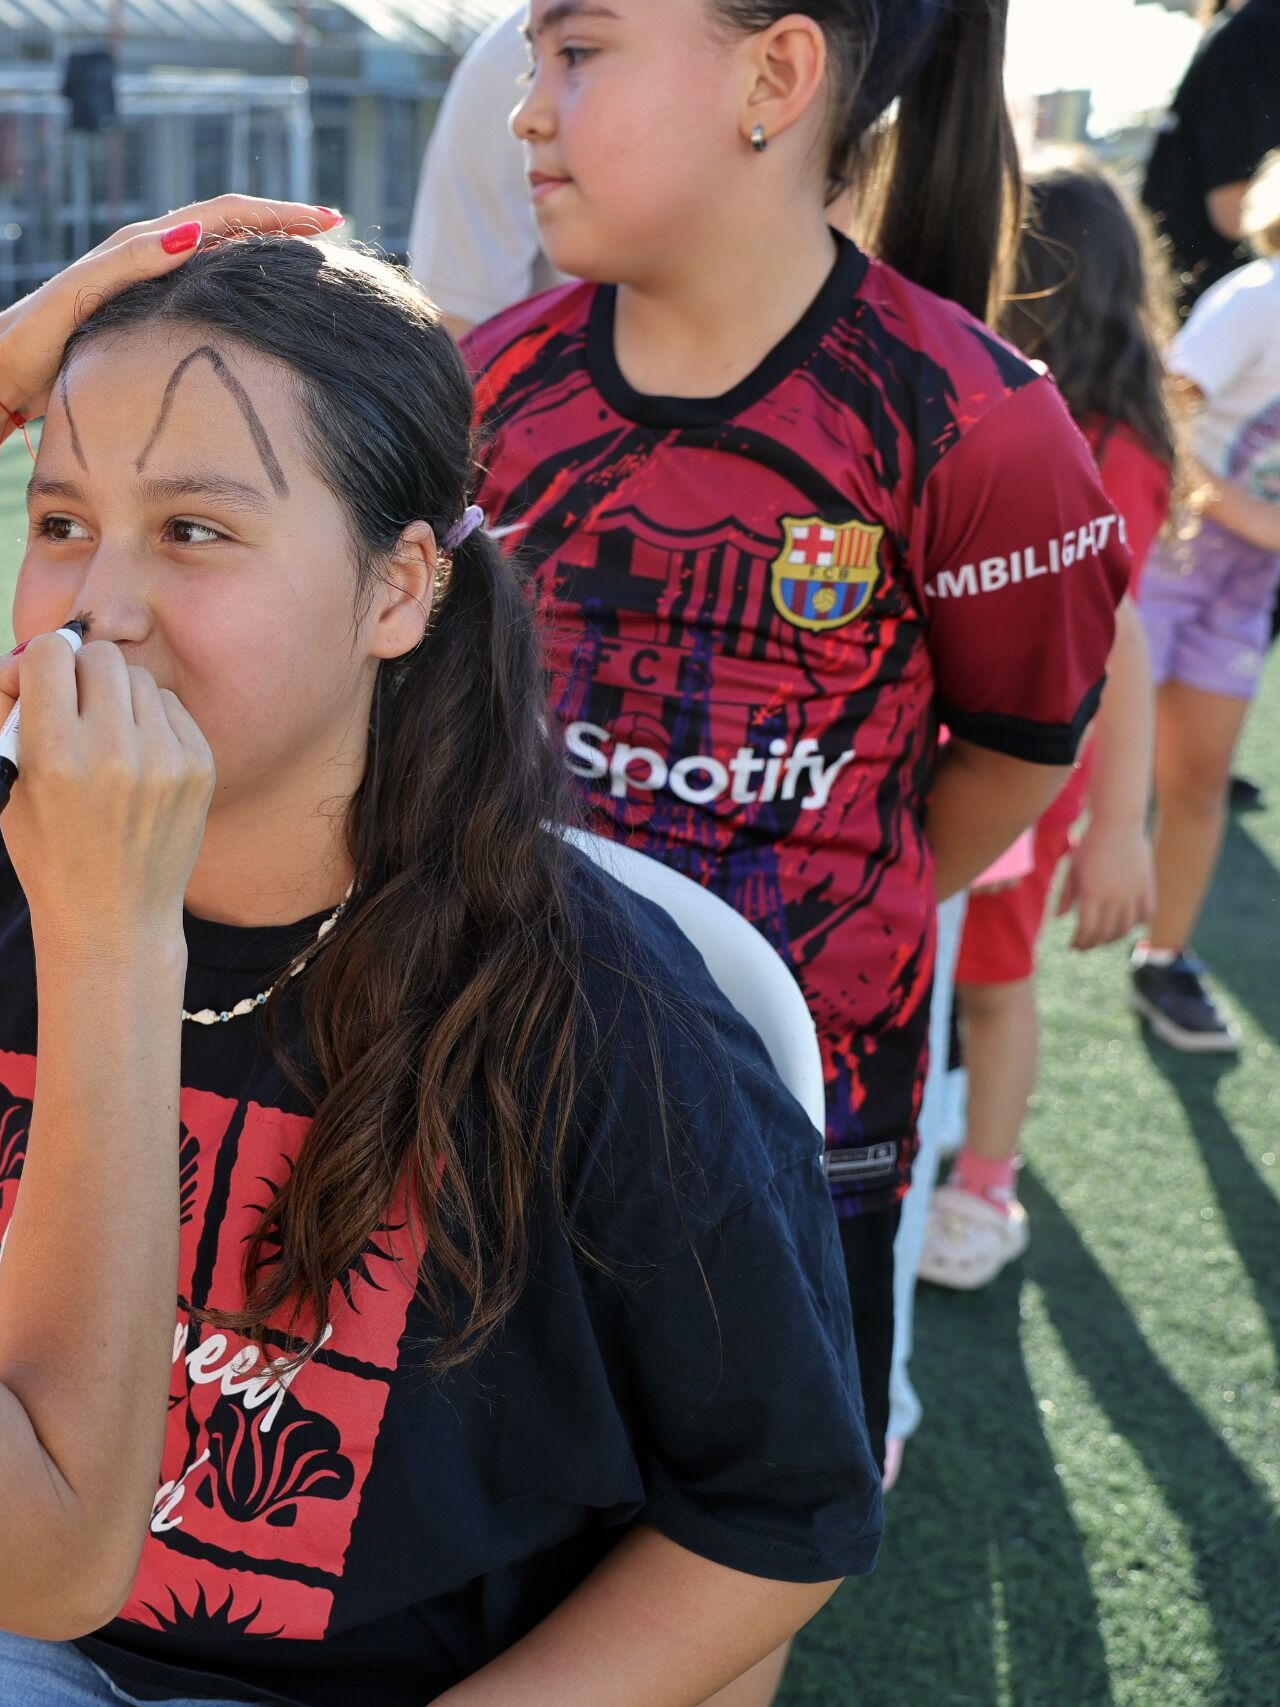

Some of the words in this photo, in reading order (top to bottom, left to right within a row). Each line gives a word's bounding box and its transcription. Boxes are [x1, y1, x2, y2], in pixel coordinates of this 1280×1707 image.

[808, 565, 849, 580] FCB
[591, 641, 713, 693] FCB
[565, 720, 856, 811] Spotify
